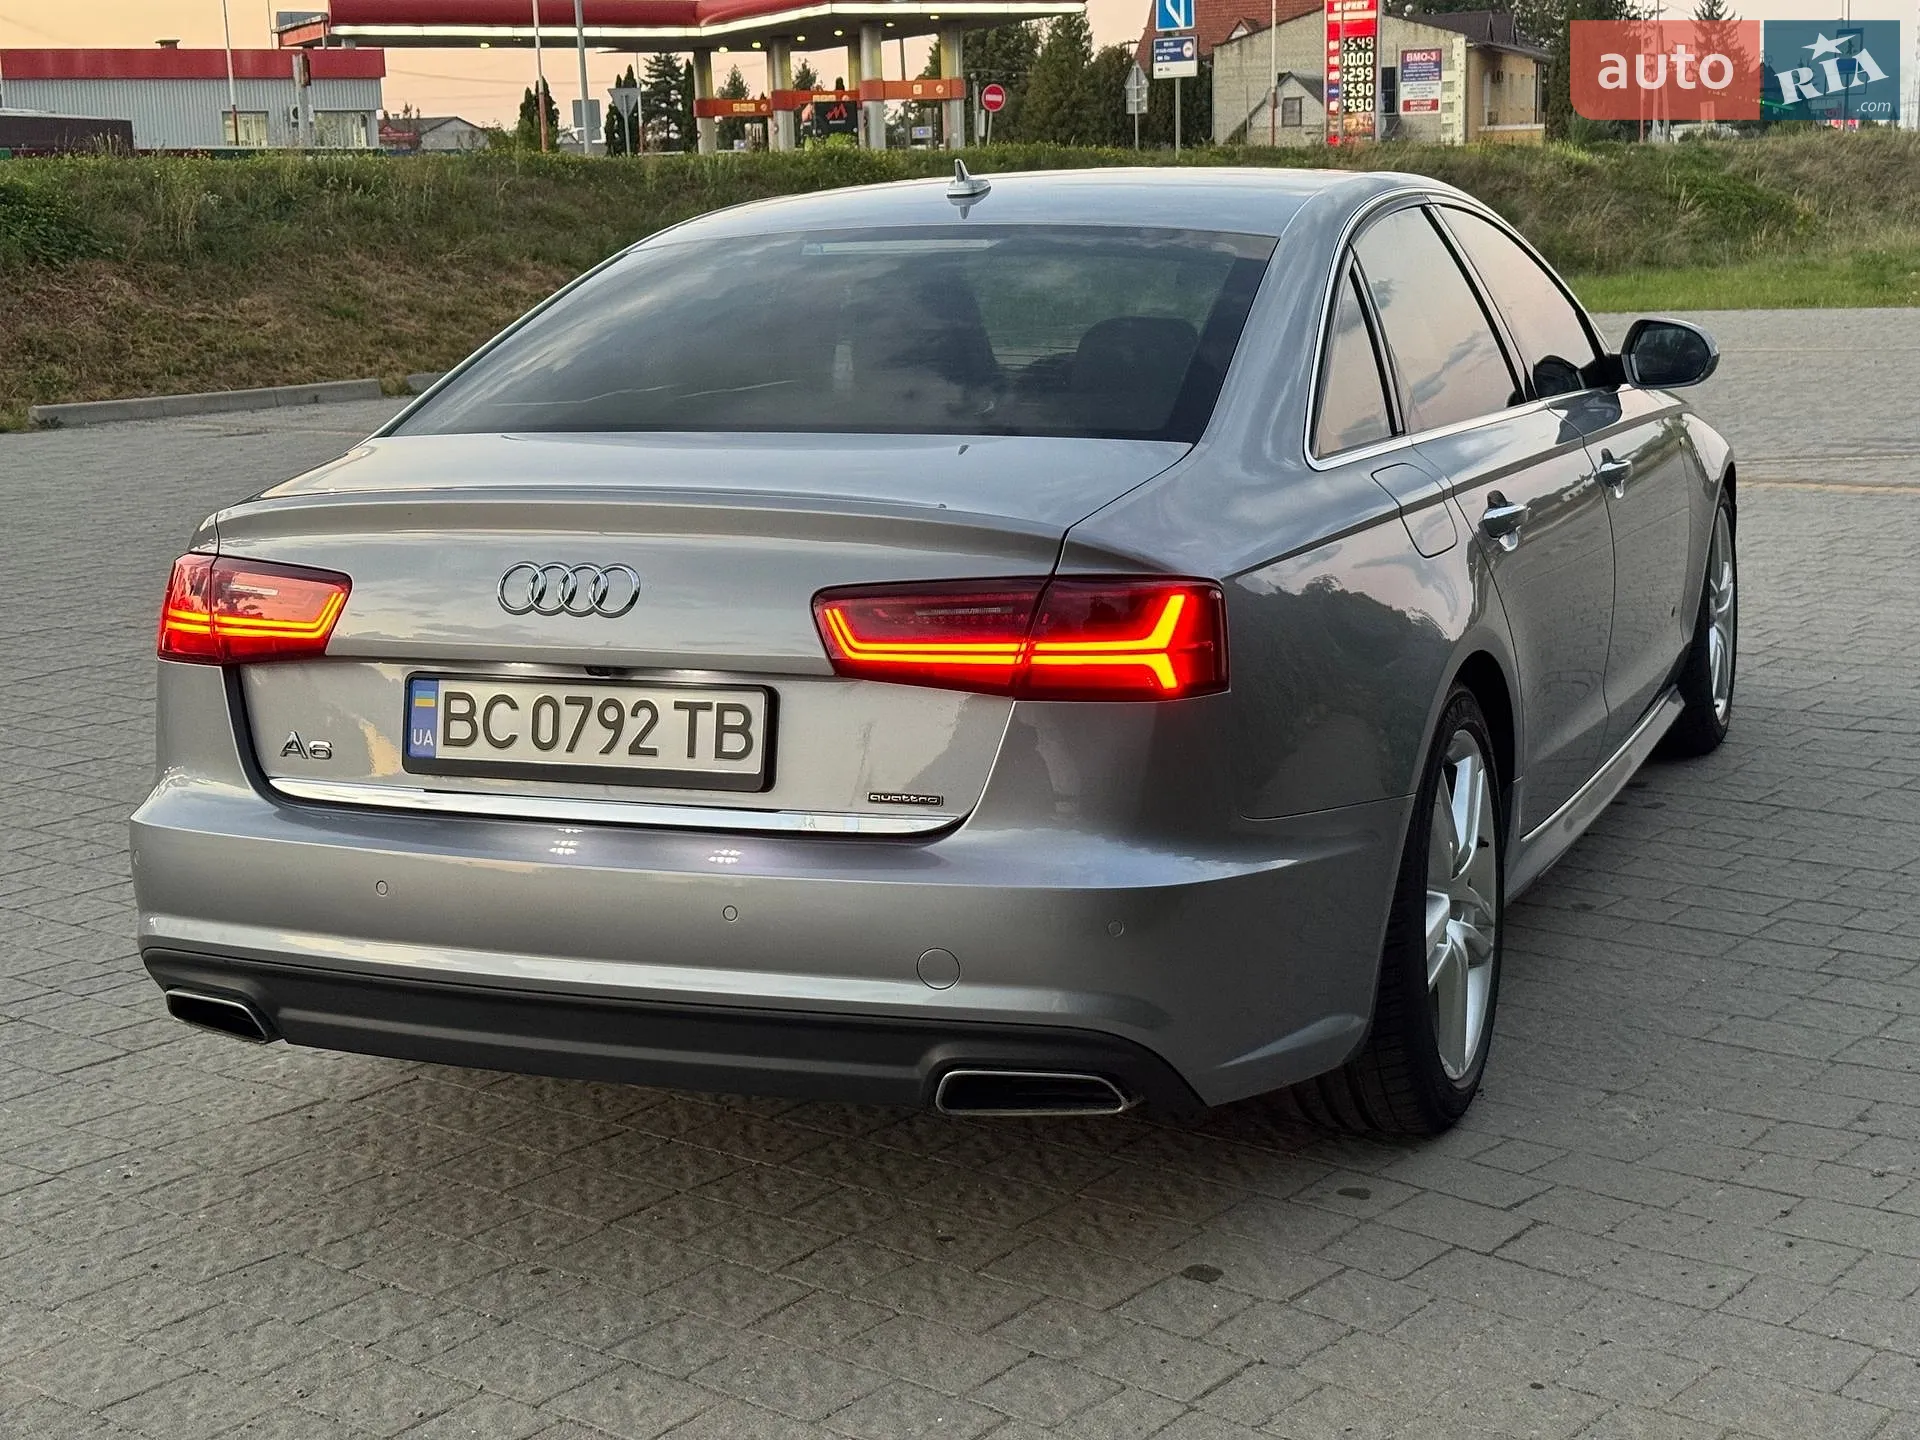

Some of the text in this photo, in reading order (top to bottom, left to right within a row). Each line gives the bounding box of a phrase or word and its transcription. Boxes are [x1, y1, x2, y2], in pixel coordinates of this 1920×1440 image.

[412, 728, 434, 746] UA
[443, 690, 754, 761] BC 0792 TB
[279, 729, 333, 760] A6
[868, 793, 940, 804] quattro
